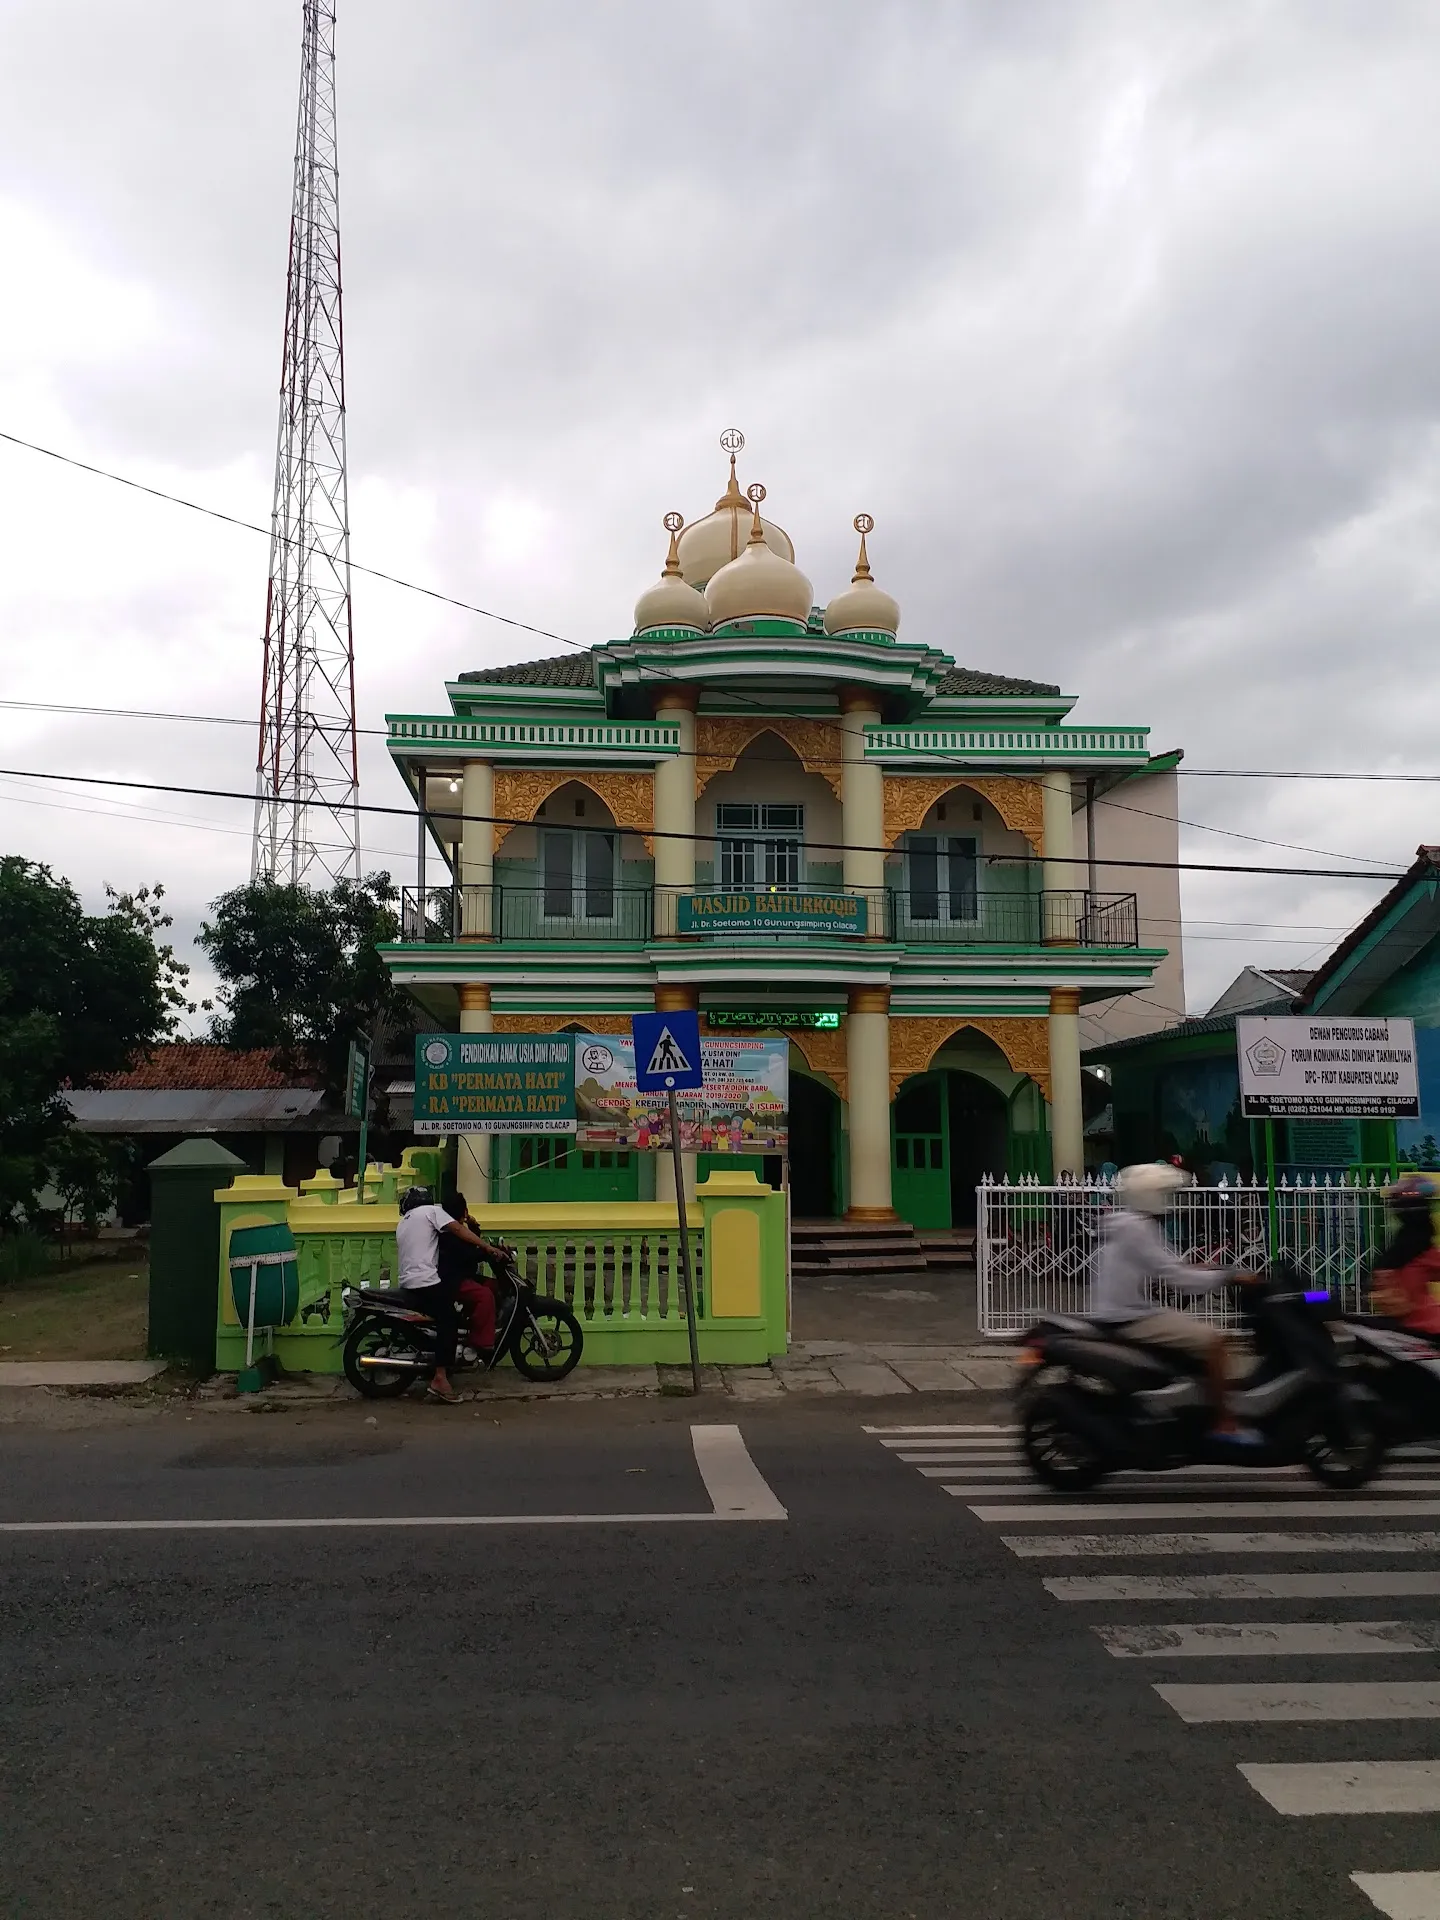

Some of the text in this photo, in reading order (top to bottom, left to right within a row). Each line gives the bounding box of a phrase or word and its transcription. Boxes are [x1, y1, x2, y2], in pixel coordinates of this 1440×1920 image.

[692, 896, 751, 914] MASJID
[713, 919, 750, 927] Soetomo
[764, 919, 831, 930] Gunungsimping
[832, 921, 857, 931] Cilacap
[1309, 1027, 1388, 1041] DEWAN PENGURUS CABANG
[460, 1043, 499, 1064] PENDIDIKAN
[501, 1043, 518, 1063] ANAK
[520, 1043, 534, 1063] USIA
[535, 1043, 548, 1063] DINI
[549, 1042, 570, 1064] (PAUD)
[704, 1042, 764, 1050] GUNUNGSIMPING
[712, 1058, 733, 1068] HATI
[1291, 1049, 1412, 1063] FORUM KOMUNIKASI DINIYAH TAKMILIYAH
[429, 1073, 448, 1090] KB
[1338, 1071, 1373, 1084] KABUPATEN
[1373, 1071, 1399, 1085] CILACAP
[429, 1096, 449, 1113] RA
[1260, 1096, 1269, 1104] Dr.
[1270, 1096, 1303, 1104] SOETOMO
[1325, 1096, 1382, 1105] GUNUNGSIMPING
[1386, 1097, 1416, 1105] CILACAP
[1269, 1105, 1287, 1113] TELP.
[1309, 1105, 1333, 1113] 521044
[421, 1121, 570, 1130] JL. DR. SOETOMO NO. 10 GUNUNGSIMPING CILACAP
